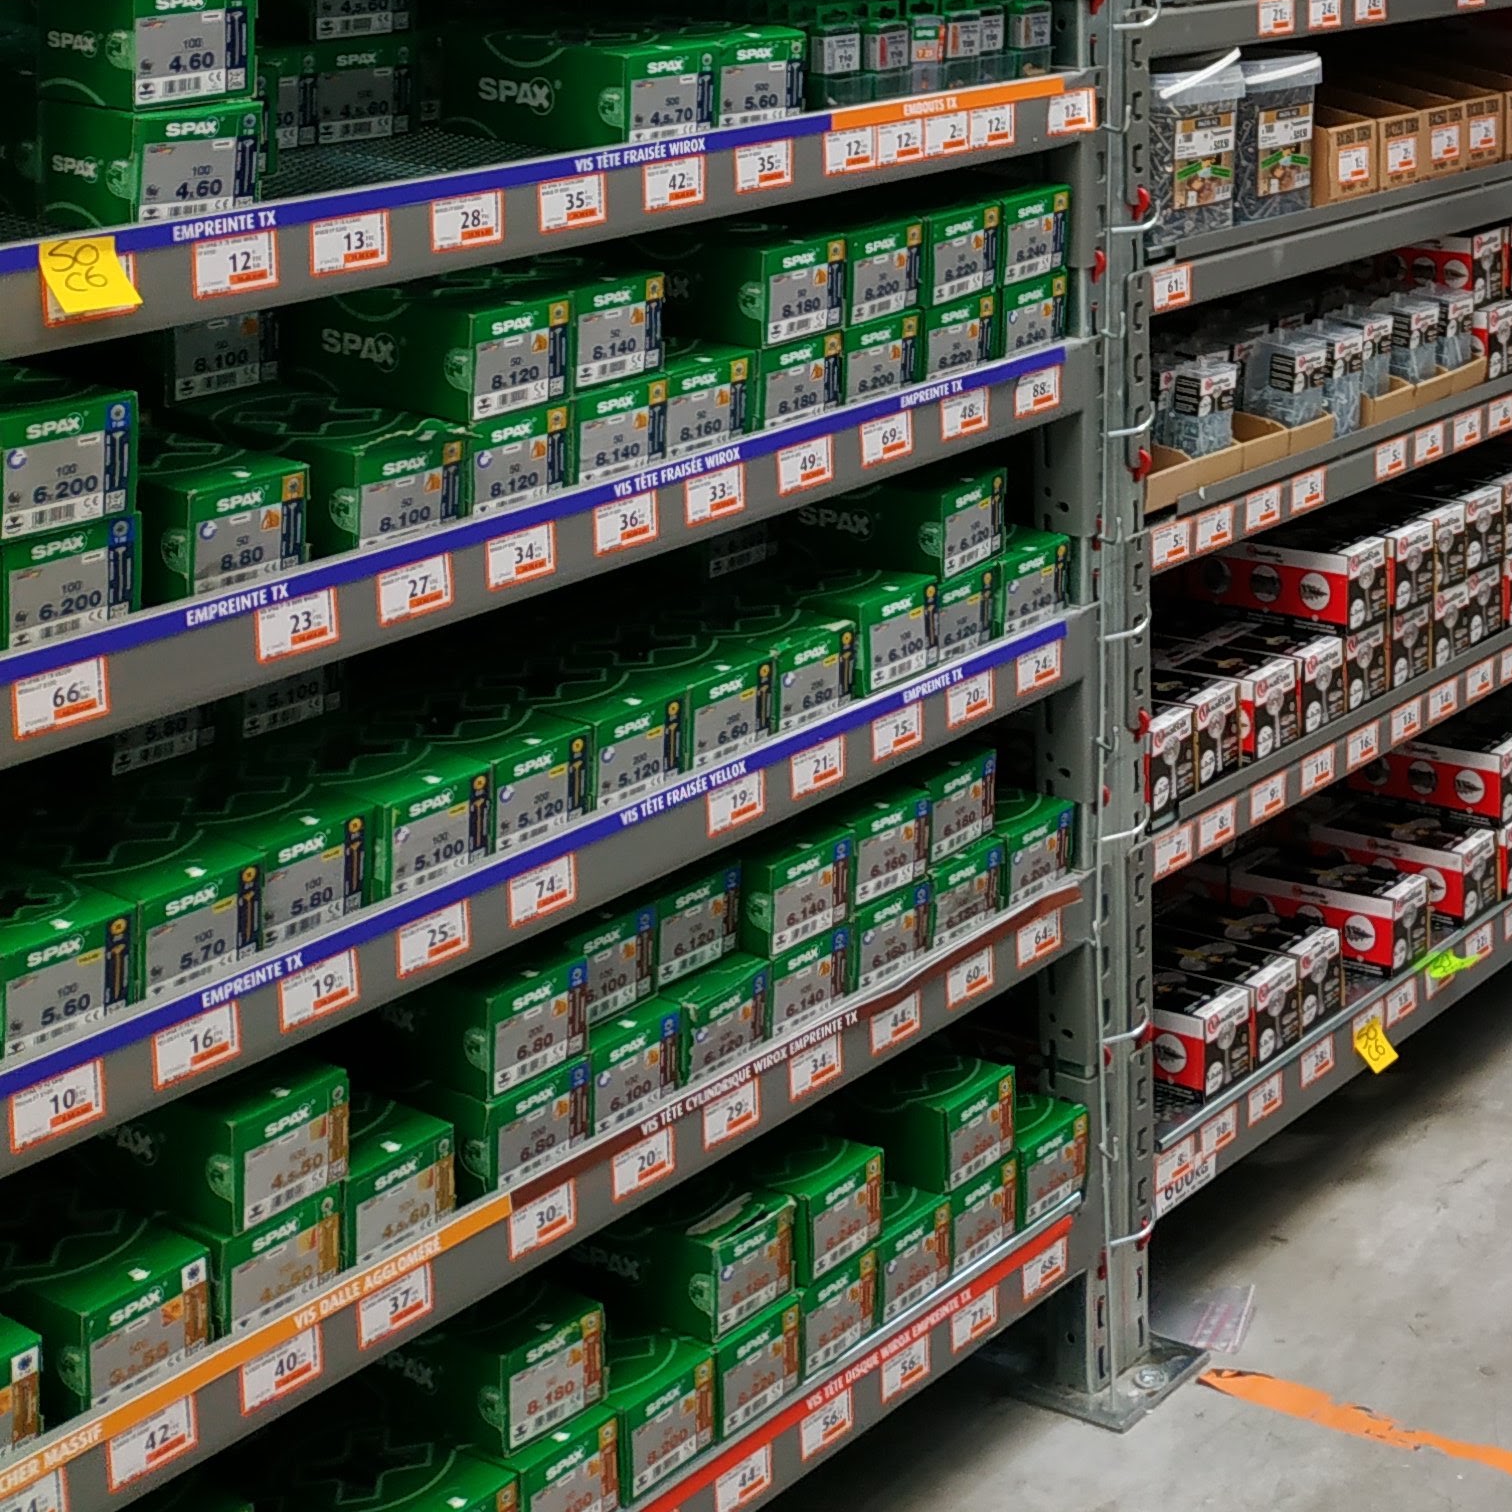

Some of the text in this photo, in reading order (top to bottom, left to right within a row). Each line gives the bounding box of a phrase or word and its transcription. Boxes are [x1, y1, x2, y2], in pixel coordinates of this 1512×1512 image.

[903, 97, 957, 117] EMBOUTS TX
[575, 137, 706, 173] VIS TÊTE FRAISÉE WIROX
[668, 172, 686, 191] 42
[173, 210, 277, 243] EMPREINTE TX
[230, 251, 251, 272] 12
[26, 416, 80, 439] SPAX
[187, 582, 289, 627] EMPREINTE TX
[52, 685, 79, 708] 66
[620, 805, 639, 826] VIS
[640, 794, 665, 818] TÊTE
[711, 760, 747, 788] YELLOX
[201, 952, 303, 1010] EMPREINTE TX
[641, 1113, 660, 1134] VIS
[753, 1045, 788, 1075] WIROX
[790, 1018, 844, 1058] EMPREINTE
[845, 1011, 858, 1029] TX
[49, 1089, 76, 1115] 10
[292, 1306, 316, 1329] VIS
[320, 1280, 361, 1318] DALLE
[43, 1423, 103, 1467] MASSIF
